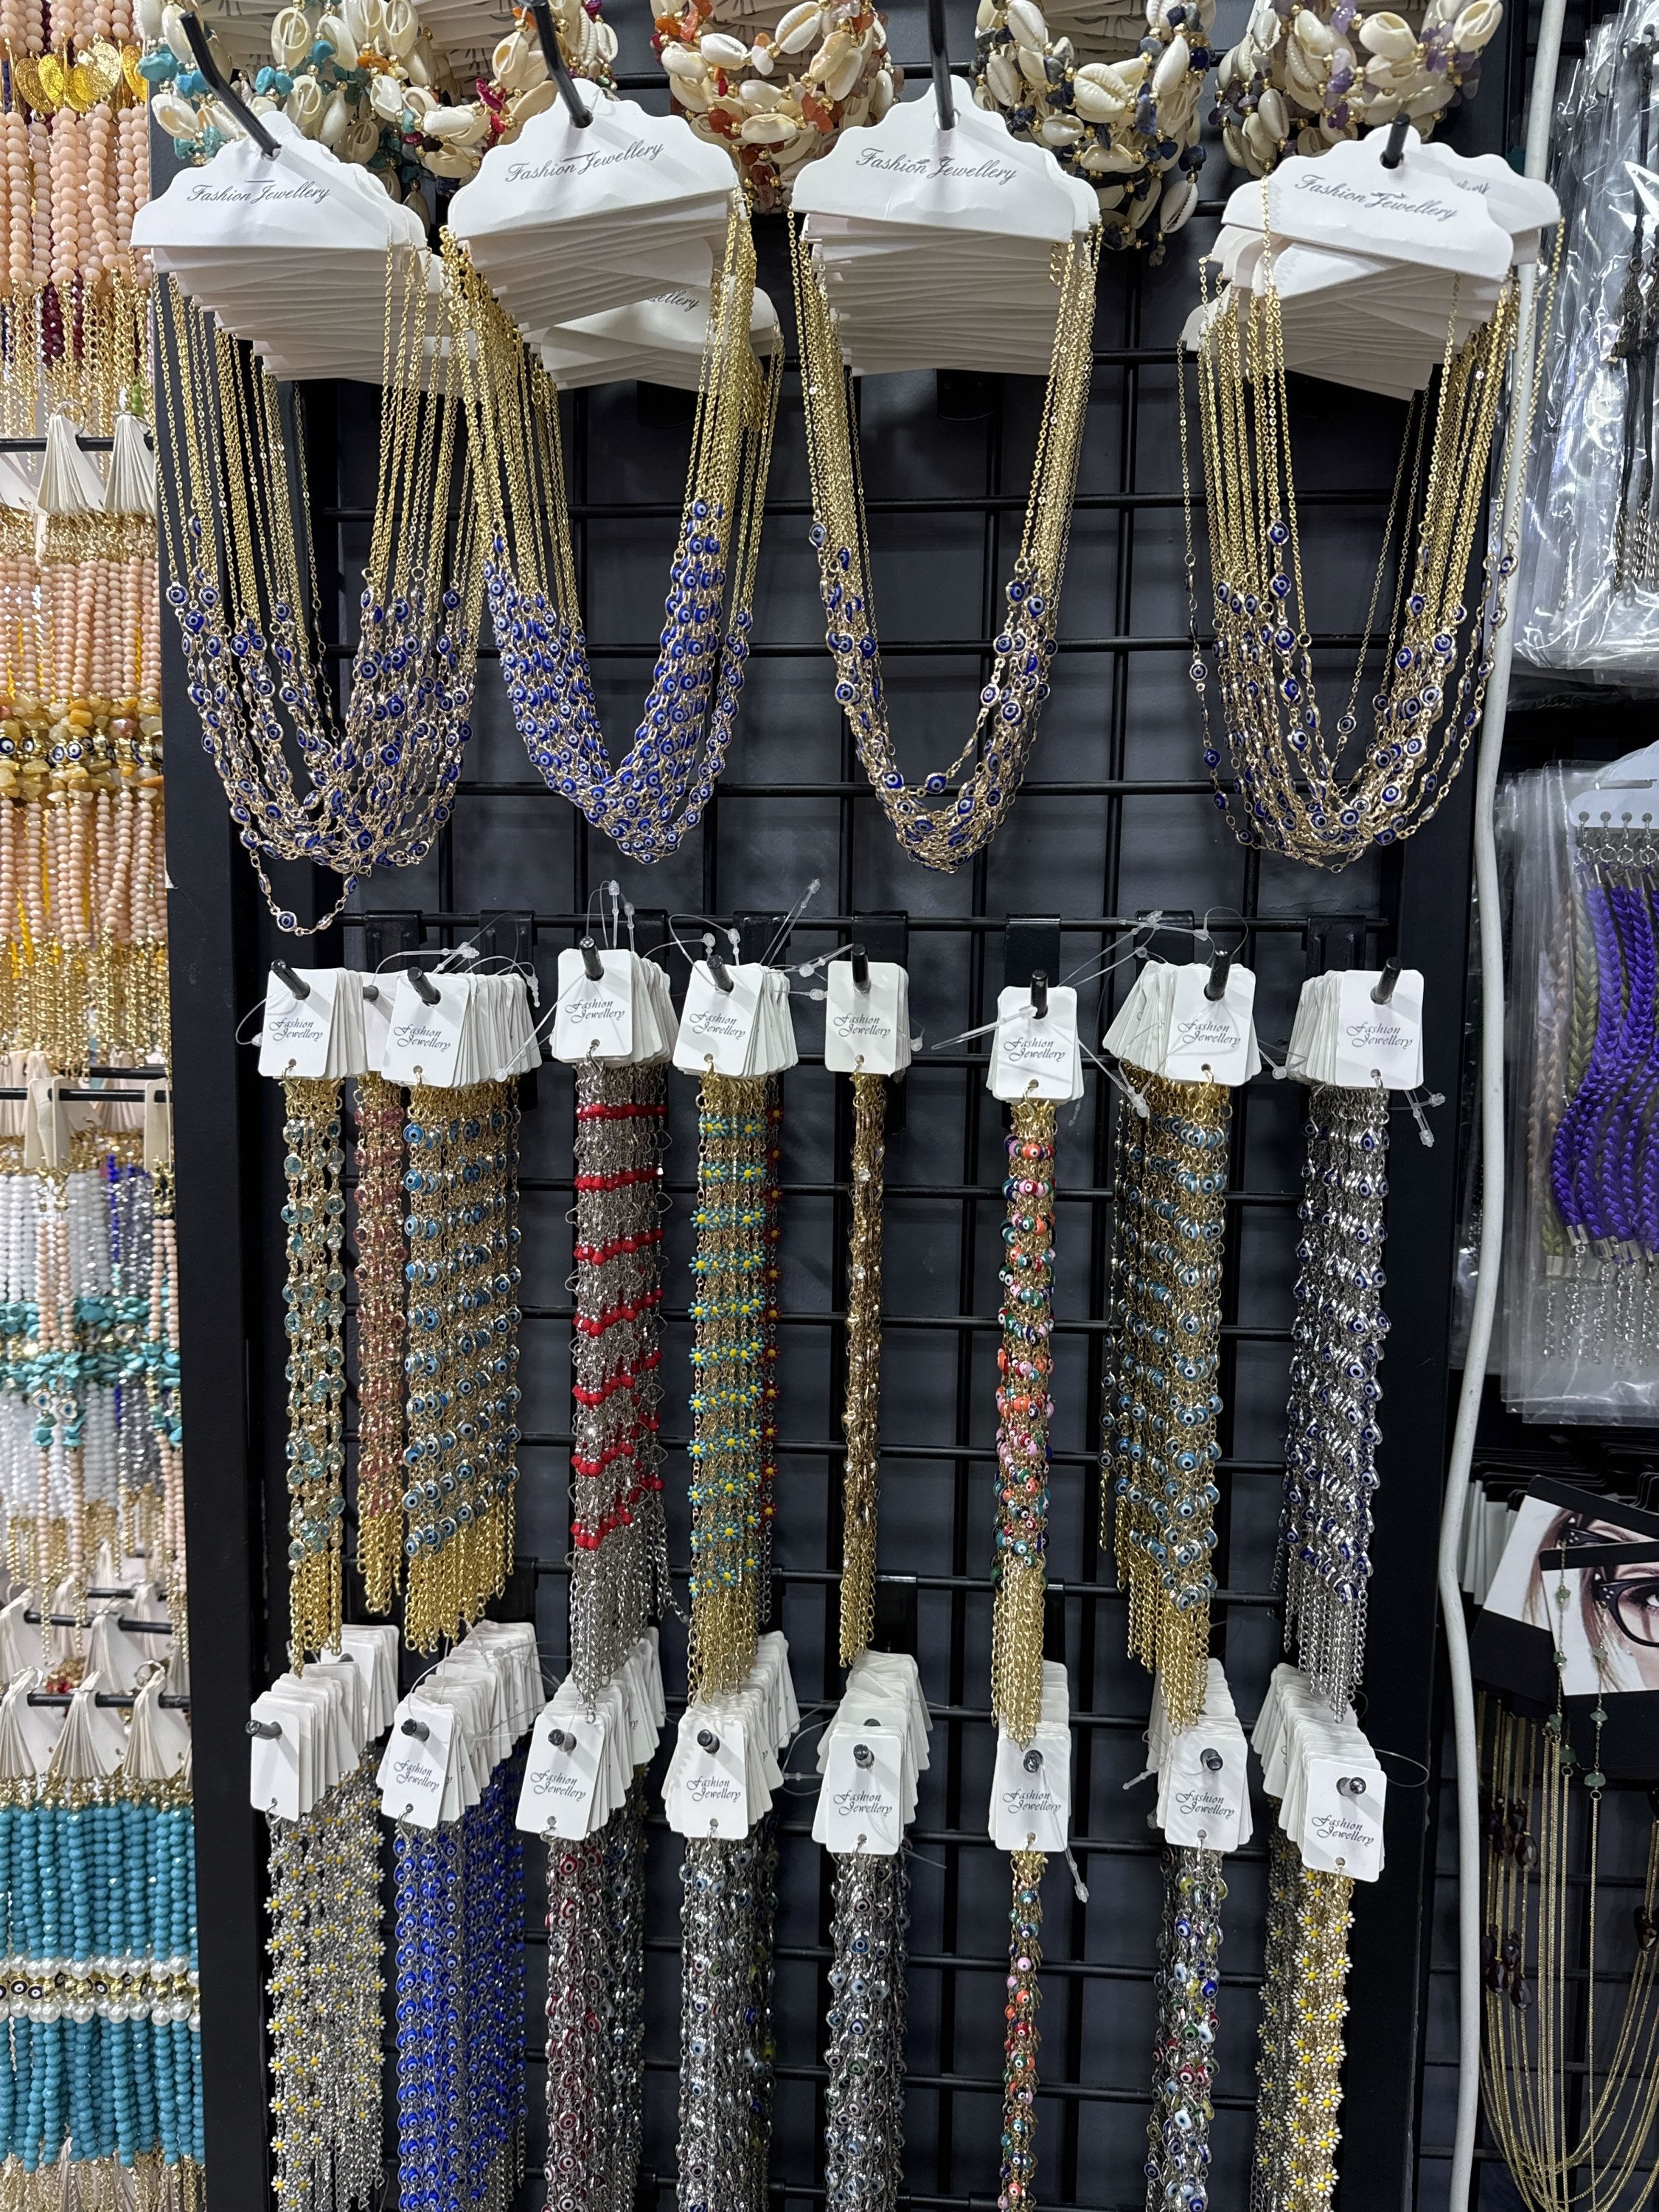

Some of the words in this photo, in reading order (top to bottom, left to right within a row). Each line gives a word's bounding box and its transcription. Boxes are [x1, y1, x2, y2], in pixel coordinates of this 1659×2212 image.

[505, 160, 577, 182] Fashion
[578, 140, 664, 175] Jewellery
[856, 148, 928, 174] Fashion
[927, 156, 1017, 185] Jewellery
[187, 184, 252, 201] Fashion
[251, 181, 330, 204] Jewellery
[1295, 174, 1366, 203] Fashion
[1365, 192, 1458, 222] Jewellery
[649, 291, 700, 313] ellery
[565, 998, 613, 1014] Fashion
[571, 1008, 625, 1023] Jewellery
[689, 1011, 737, 1025] Fashion
[833, 1013, 880, 1026] Fashion
[269, 1017, 314, 1031] Fashion
[394, 1023, 442, 1037] Fashion
[692, 1021, 745, 1040] Jewellery
[838, 1023, 891, 1038] Jewellery
[1178, 1020, 1230, 1033] Fashion
[1346, 1022, 1401, 1036] Fashion
[273, 1029, 324, 1042] Jewellery
[397, 1034, 451, 1052] Jewellery
[1182, 1031, 1241, 1048] Jewellery
[1352, 1033, 1413, 1049] Jewellery
[1004, 1037, 1054, 1050] Fashion
[1009, 1048, 1065, 1062] Jewellery
[394, 1759, 432, 1776] Fashion
[396, 1771, 439, 1792] Jewellery
[530, 1770, 577, 1785] Fashion
[686, 1775, 730, 1790] Fashion
[533, 1781, 586, 1801] Jewellery
[692, 1787, 741, 1802] Jewellery
[833, 1790, 881, 1805] Fashion
[1003, 1789, 1051, 1802] Fashion
[1175, 1790, 1224, 1804] Fashion
[838, 1801, 892, 1816] Jewellery
[1008, 1799, 1061, 1814] Jewellery
[1180, 1801, 1235, 1819] Jewellery
[1312, 1815, 1363, 1831] Fashion
[1317, 1826, 1374, 1846] Jewellery
